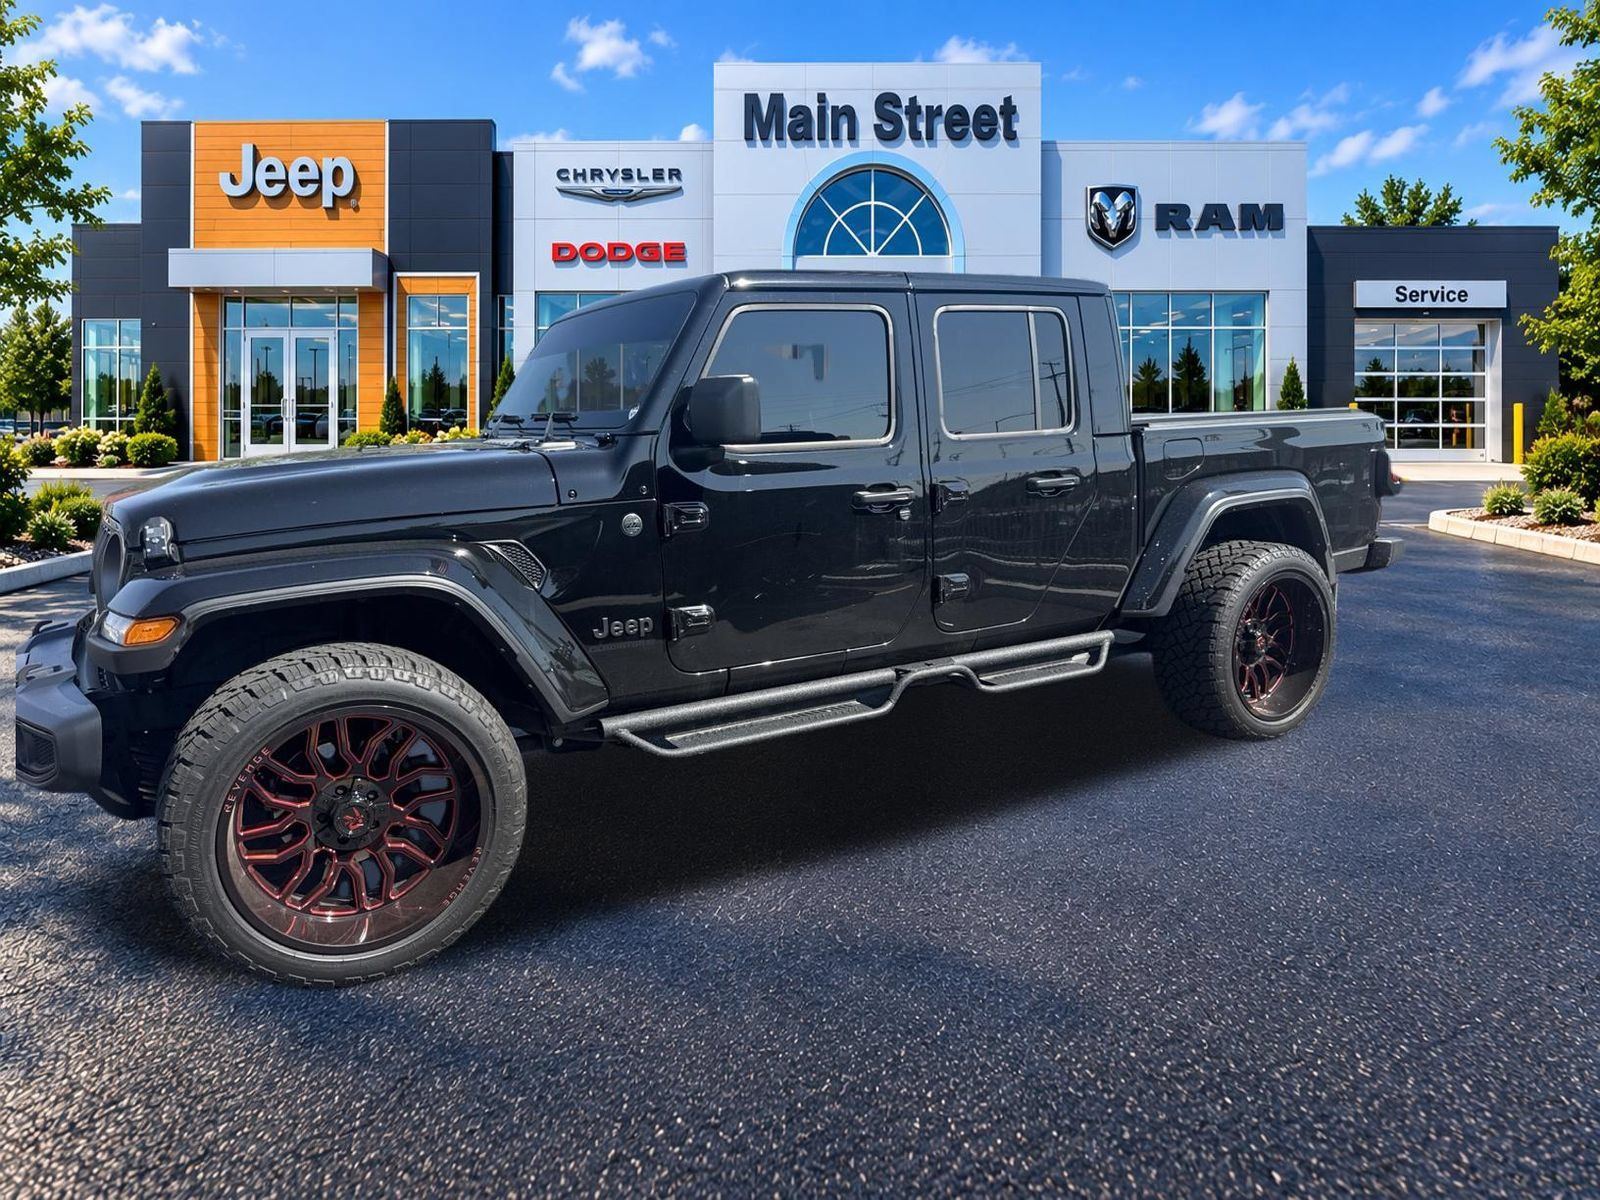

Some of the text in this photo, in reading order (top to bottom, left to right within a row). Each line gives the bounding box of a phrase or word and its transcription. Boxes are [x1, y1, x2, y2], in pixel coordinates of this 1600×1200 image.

[743, 91, 1018, 143] Main Street
[219, 143, 354, 207] Jeep
[556, 167, 683, 184] CHRYSLER
[1155, 203, 1284, 232] RAM
[551, 242, 687, 262] DODGE
[1395, 285, 1469, 304] Service
[592, 616, 653, 638] Jeep
[224, 746, 272, 814] REVENGE
[441, 846, 483, 909] REVENGE
